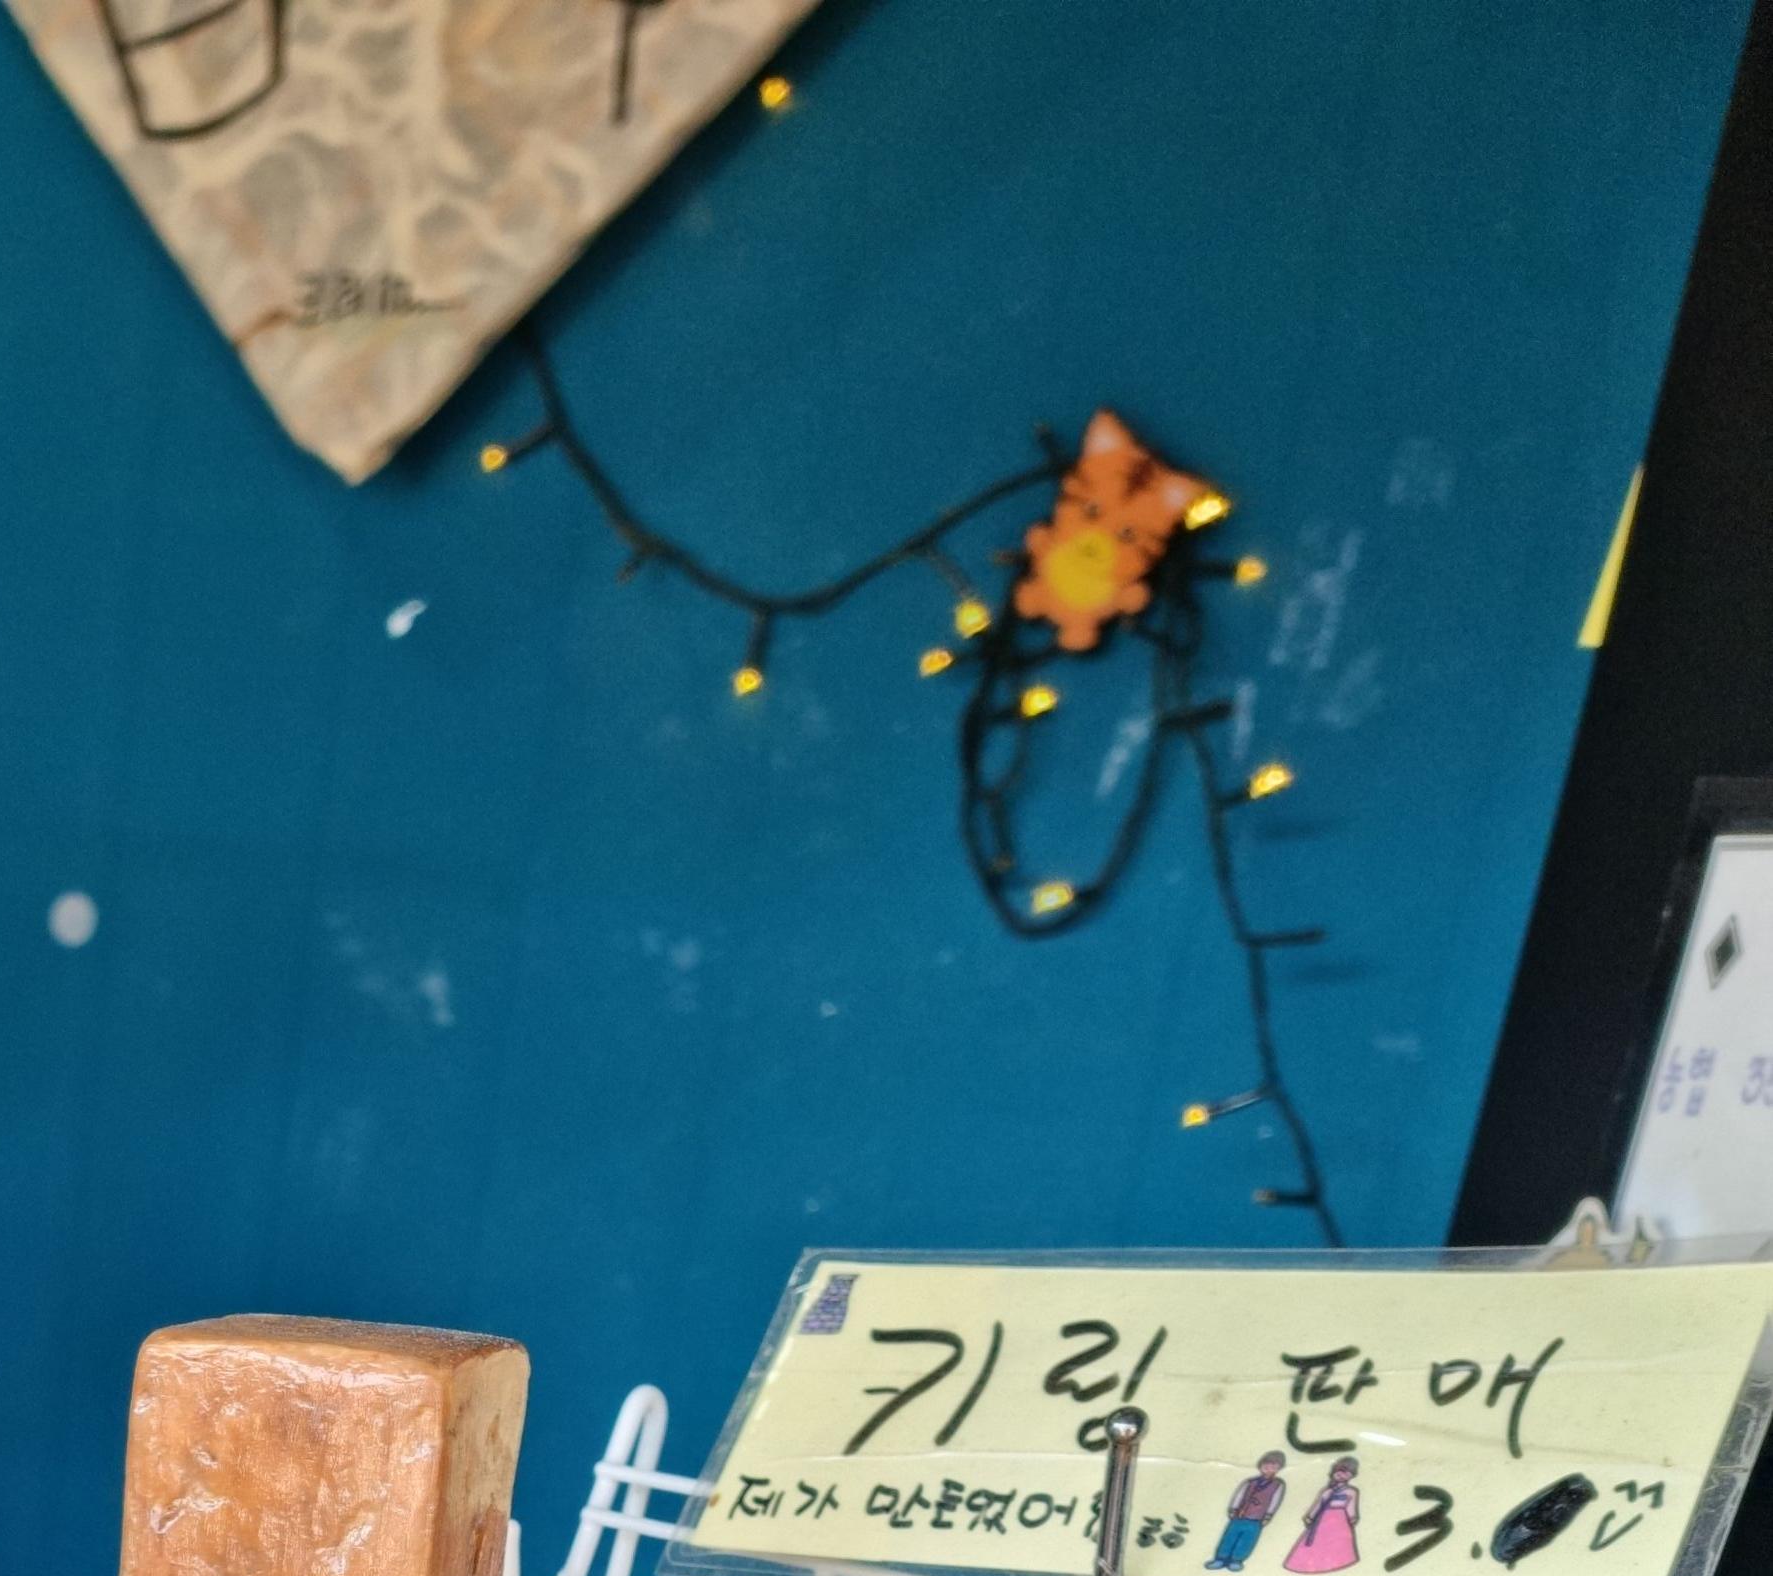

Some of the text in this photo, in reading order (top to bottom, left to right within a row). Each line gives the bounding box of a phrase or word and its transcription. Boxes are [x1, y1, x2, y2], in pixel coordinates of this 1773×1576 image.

[843, 1318, 1566, 1458] 키링 판매
[728, 1474, 840, 1521] 제가
